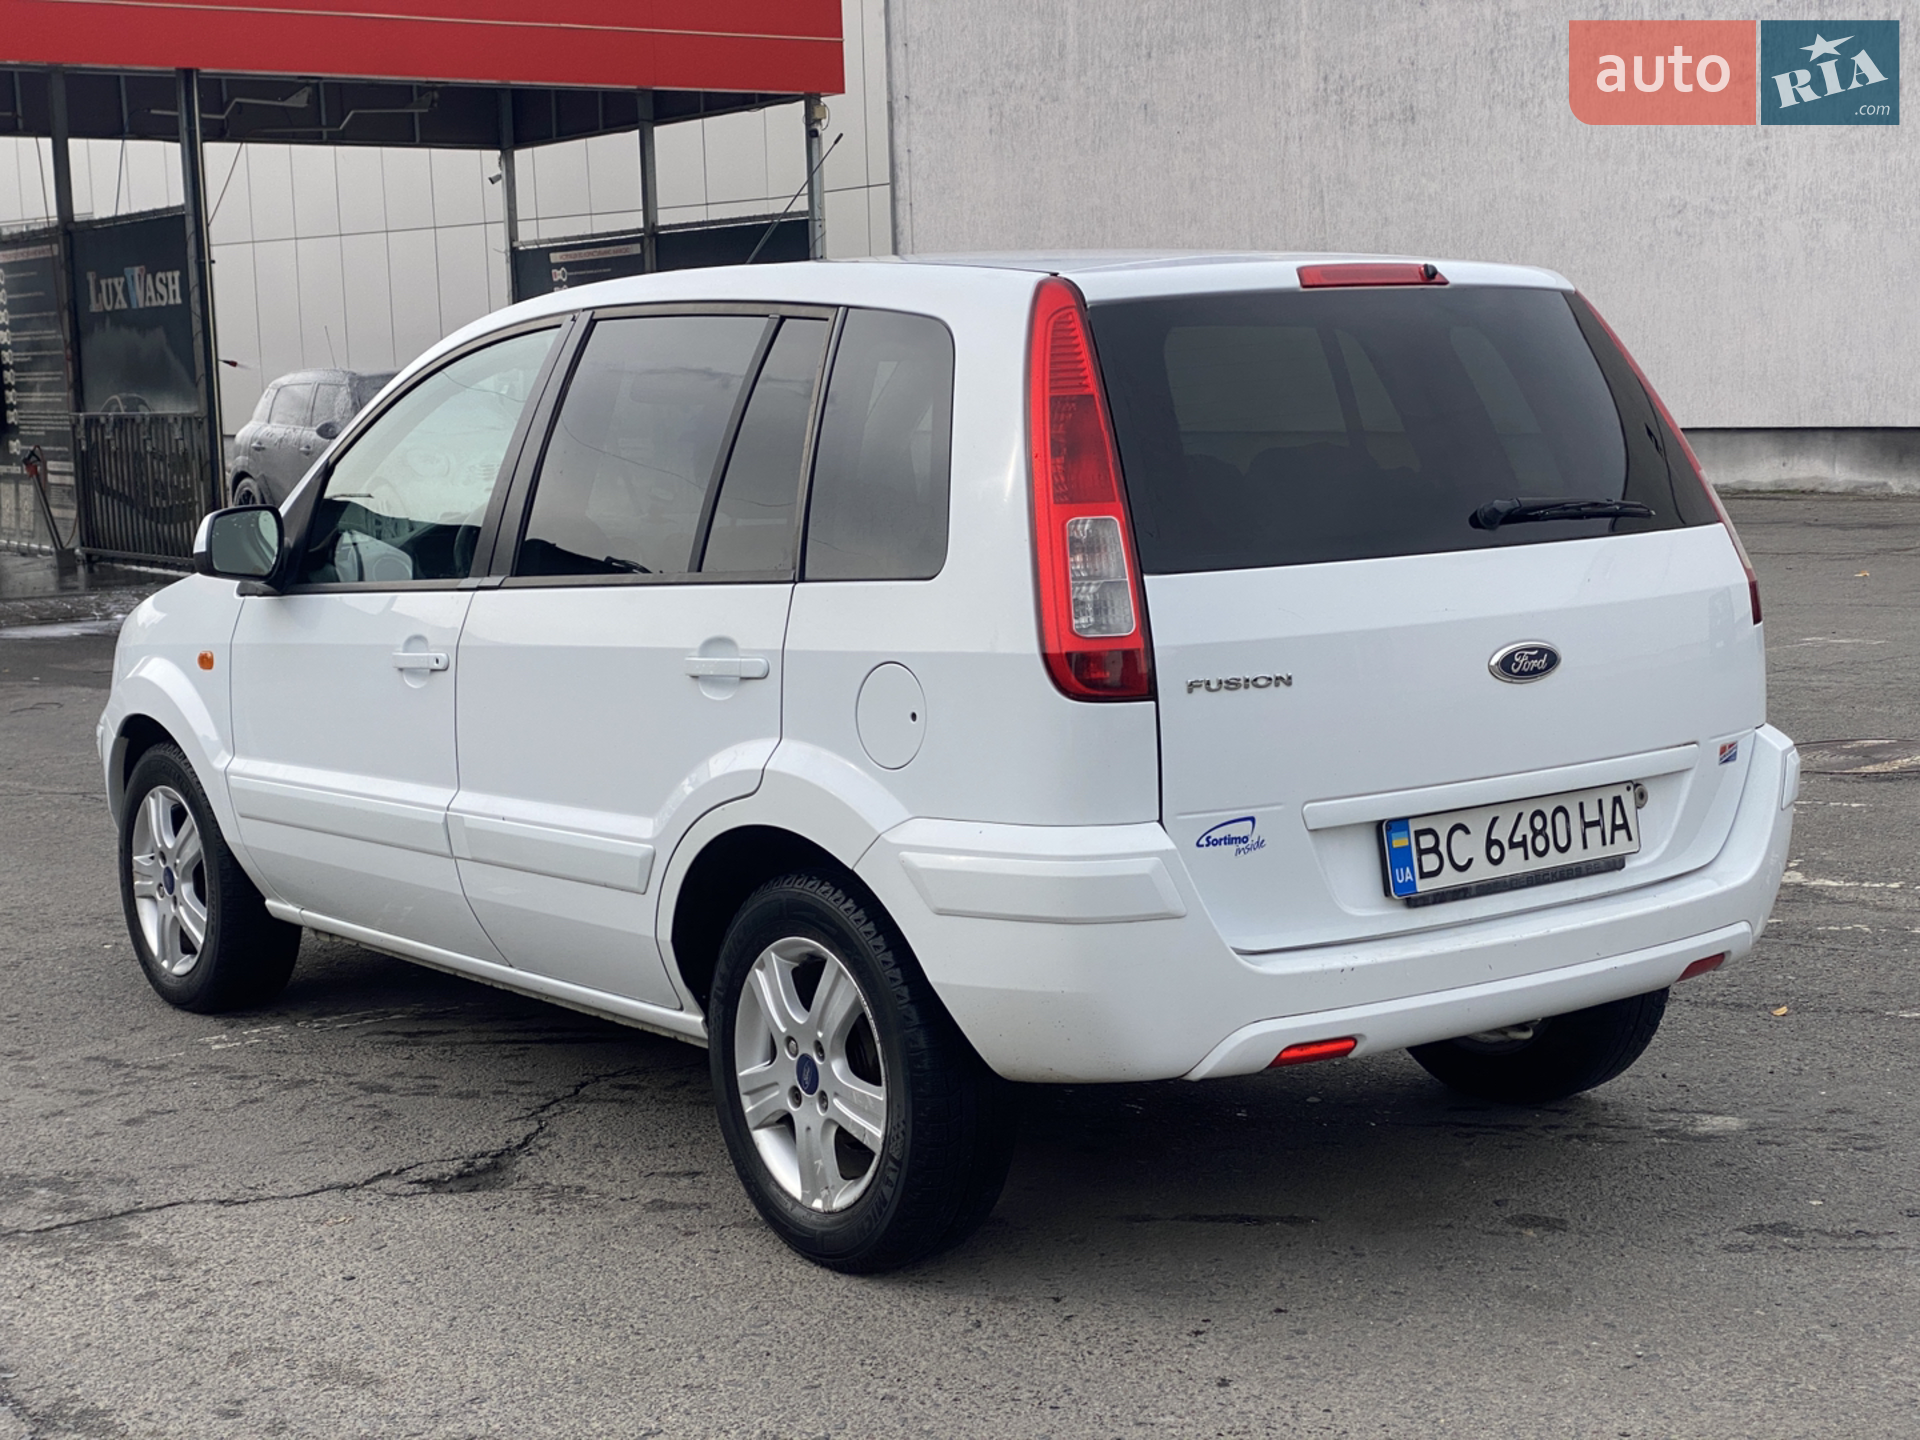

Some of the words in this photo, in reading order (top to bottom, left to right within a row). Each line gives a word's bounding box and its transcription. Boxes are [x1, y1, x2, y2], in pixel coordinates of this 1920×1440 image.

[1511, 649, 1548, 674] Ford
[1186, 672, 1293, 694] FUSION
[1204, 833, 1250, 848] Sortimo
[1234, 835, 1267, 857] inside
[1414, 822, 1475, 880] BC
[1485, 805, 1572, 867] 6480
[1578, 795, 1633, 850] HA
[1395, 867, 1414, 883] UA
